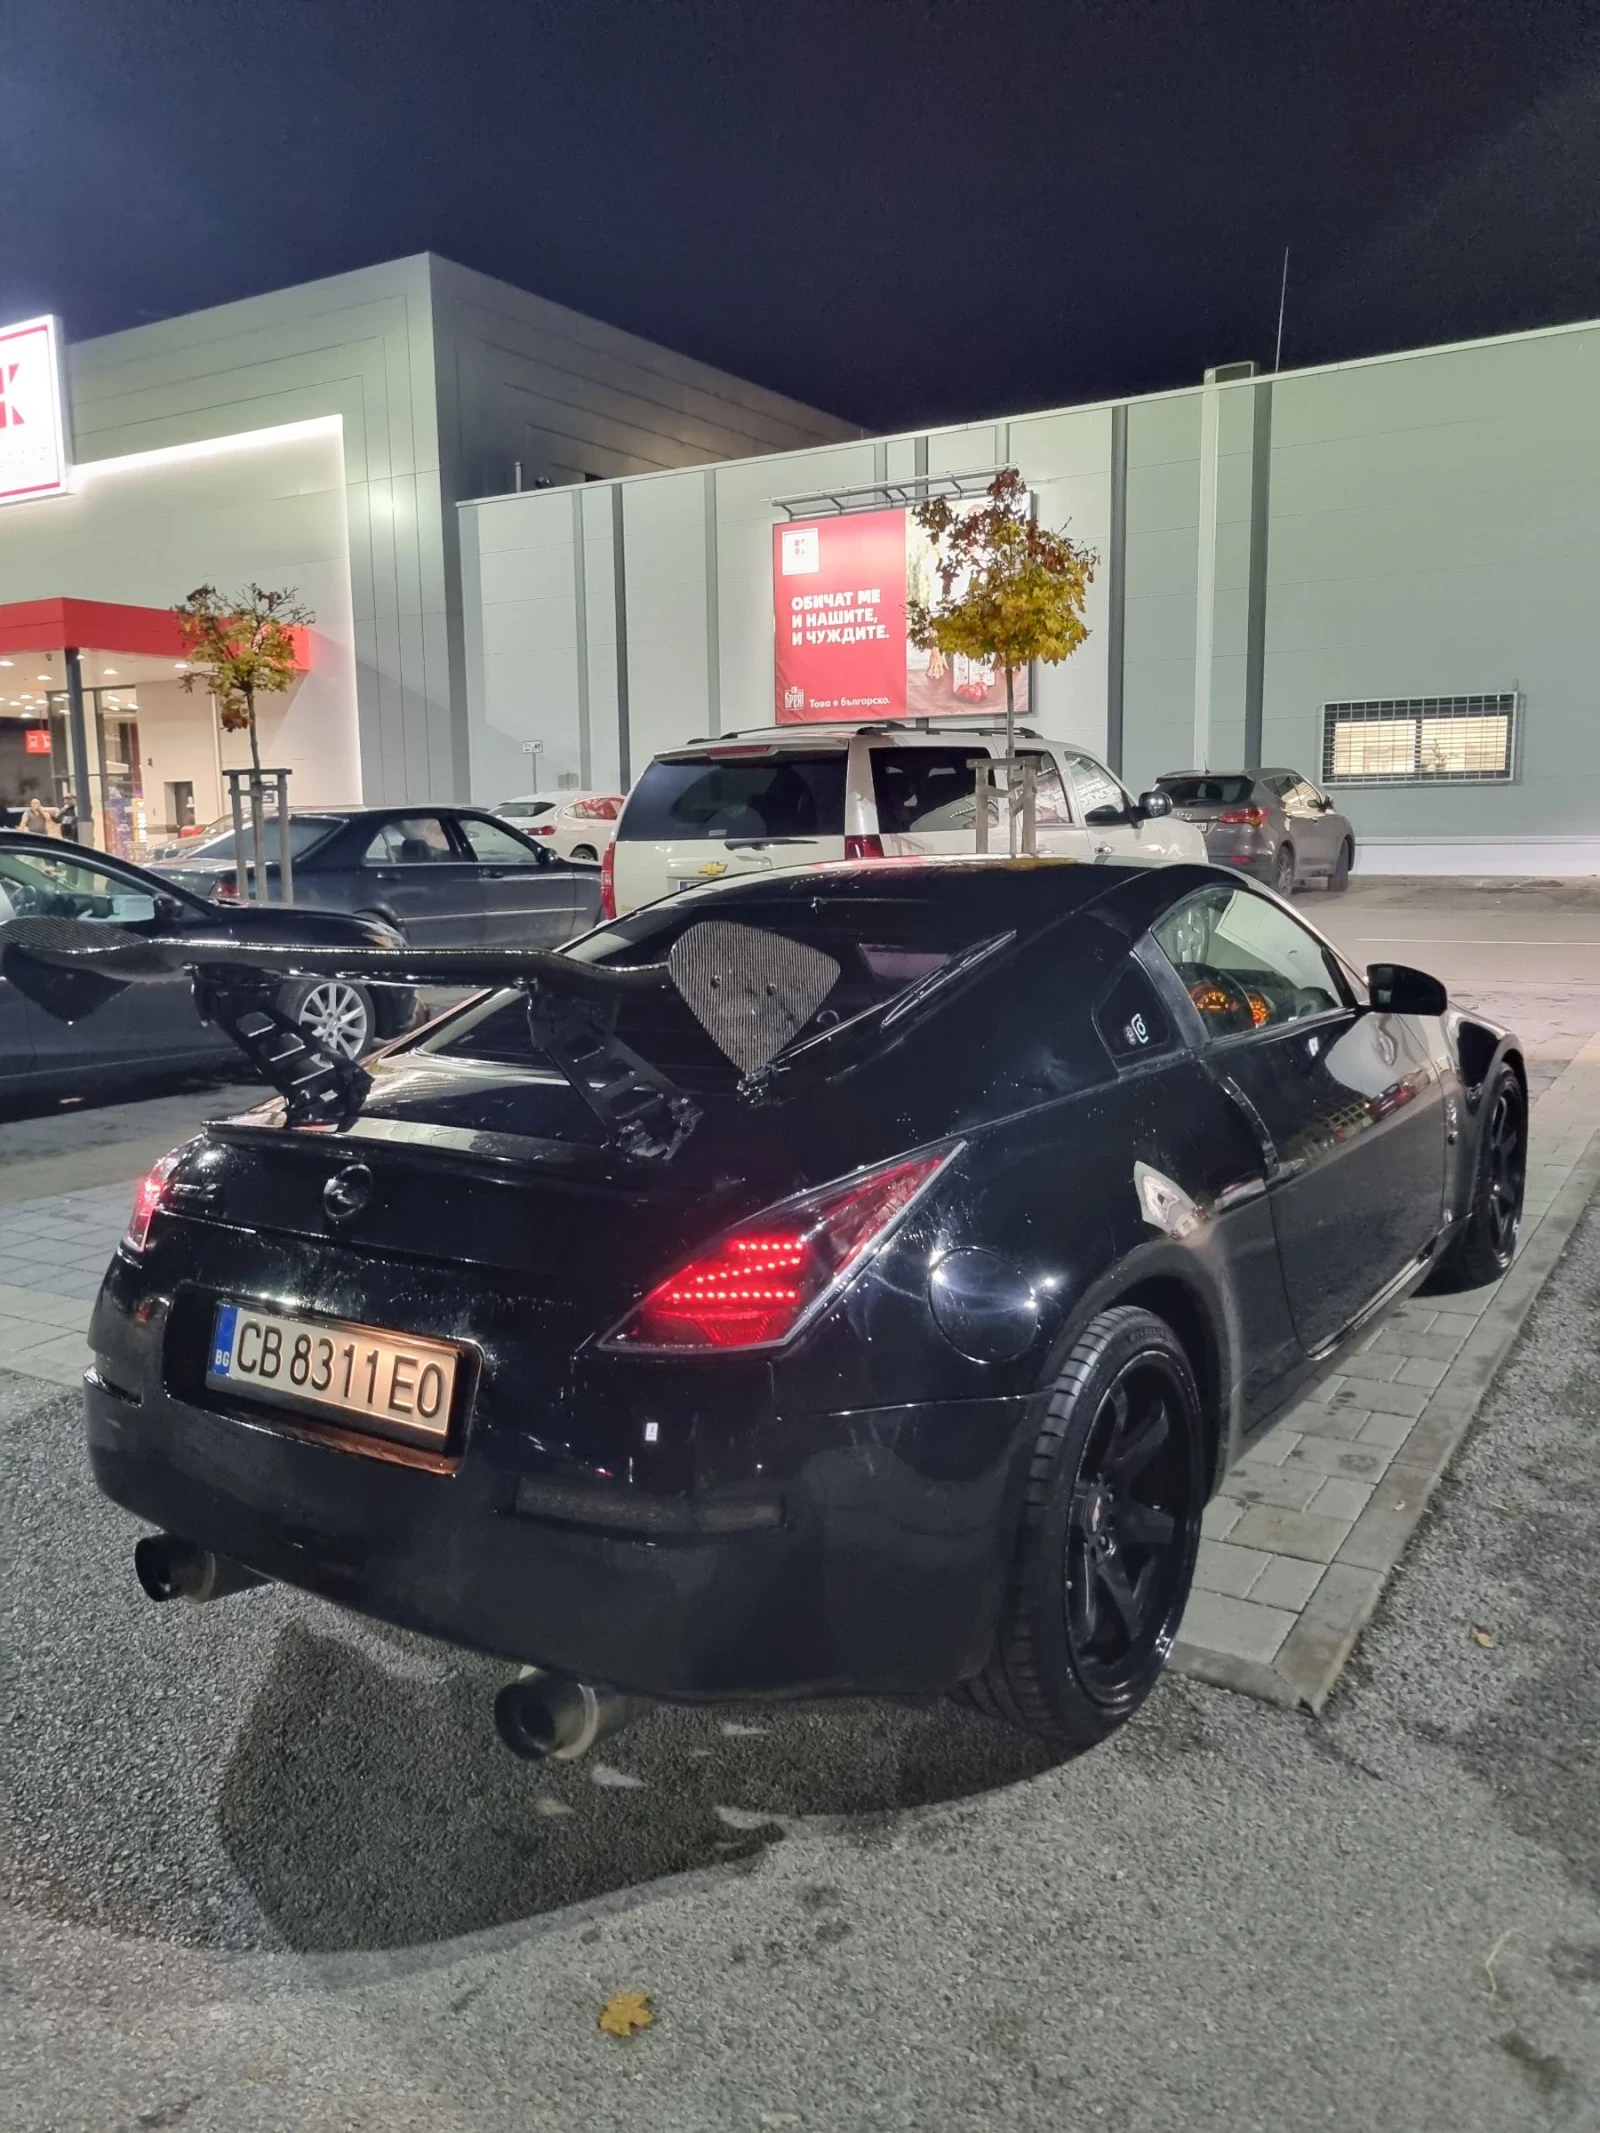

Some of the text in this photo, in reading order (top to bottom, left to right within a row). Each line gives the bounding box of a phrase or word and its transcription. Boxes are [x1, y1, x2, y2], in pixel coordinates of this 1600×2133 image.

[791, 588, 881, 611] ОБИЧАТ МЕ
[791, 607, 878, 629] И НАШИТЕ,
[791, 624, 890, 646] И ЧУЖДИТЕ.
[809, 696, 891, 709] Това е българско.
[214, 1348, 231, 1367] BG
